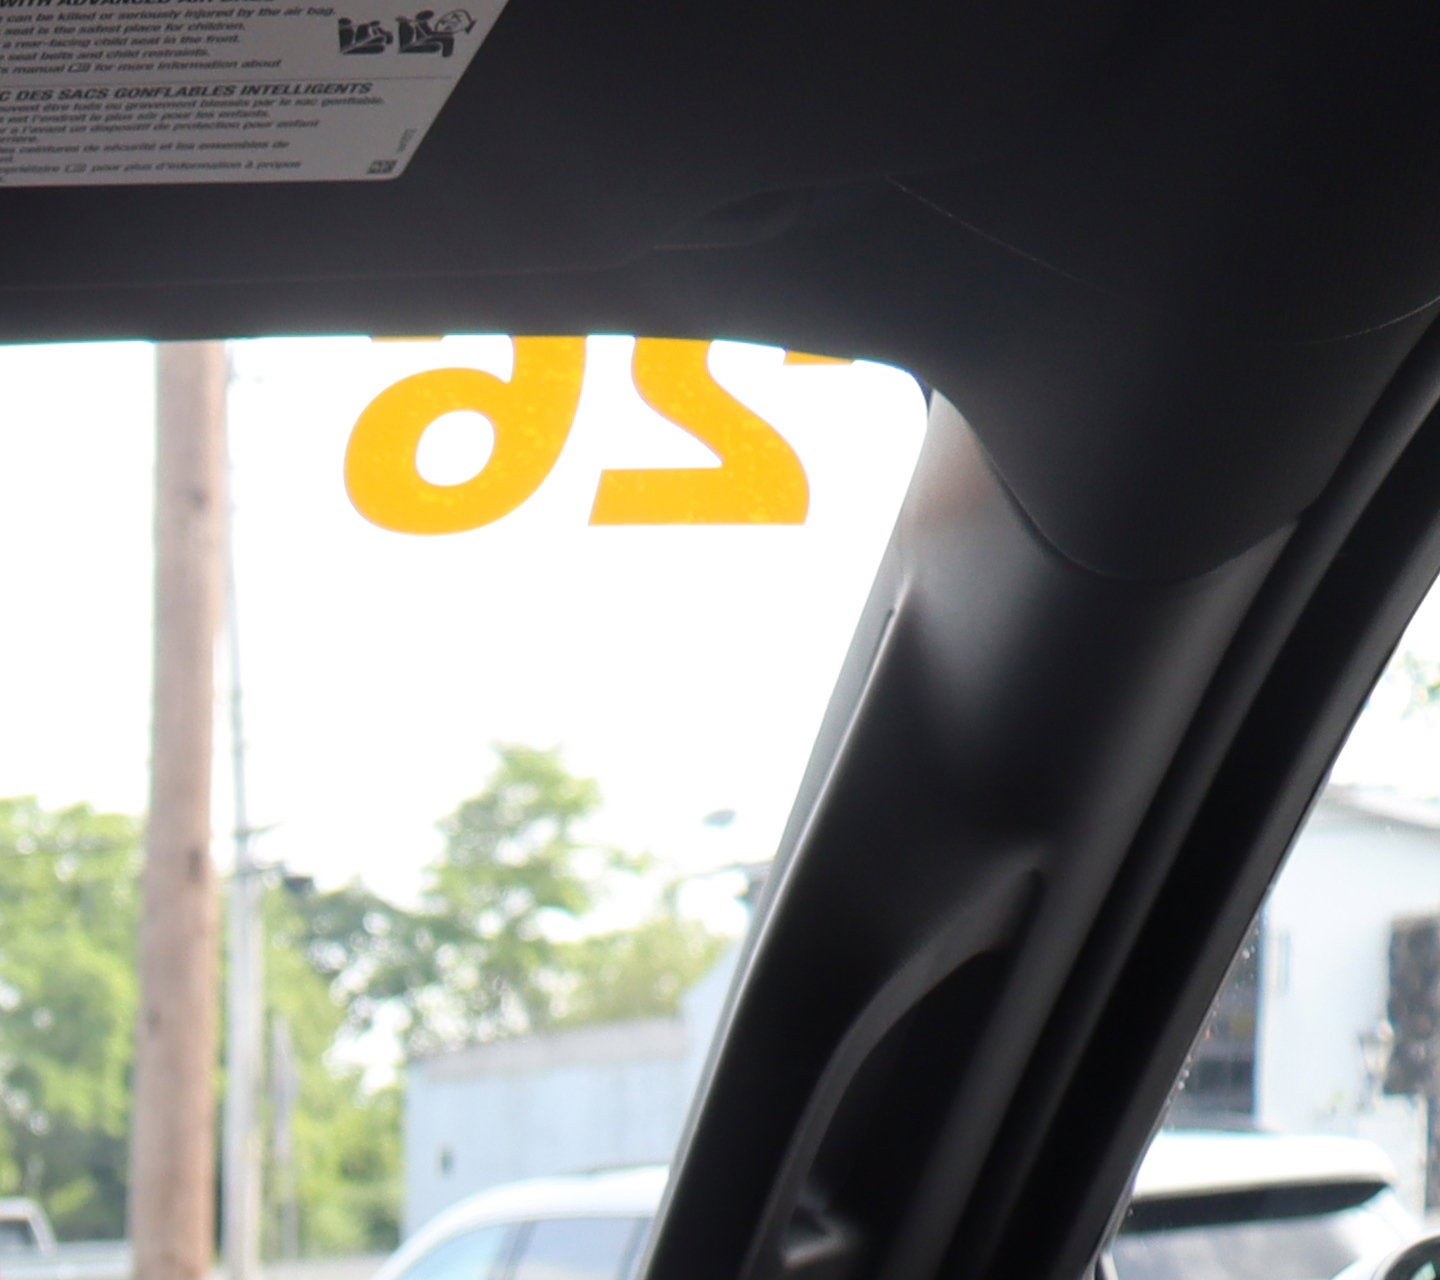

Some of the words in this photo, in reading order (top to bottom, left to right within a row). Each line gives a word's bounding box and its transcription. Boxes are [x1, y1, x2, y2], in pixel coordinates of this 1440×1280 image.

[13, 90, 56, 100] DES
[55, 89, 111, 99] SACS
[110, 86, 238, 98] GONFLABLES
[237, 83, 374, 95] INTELLIGENTS
